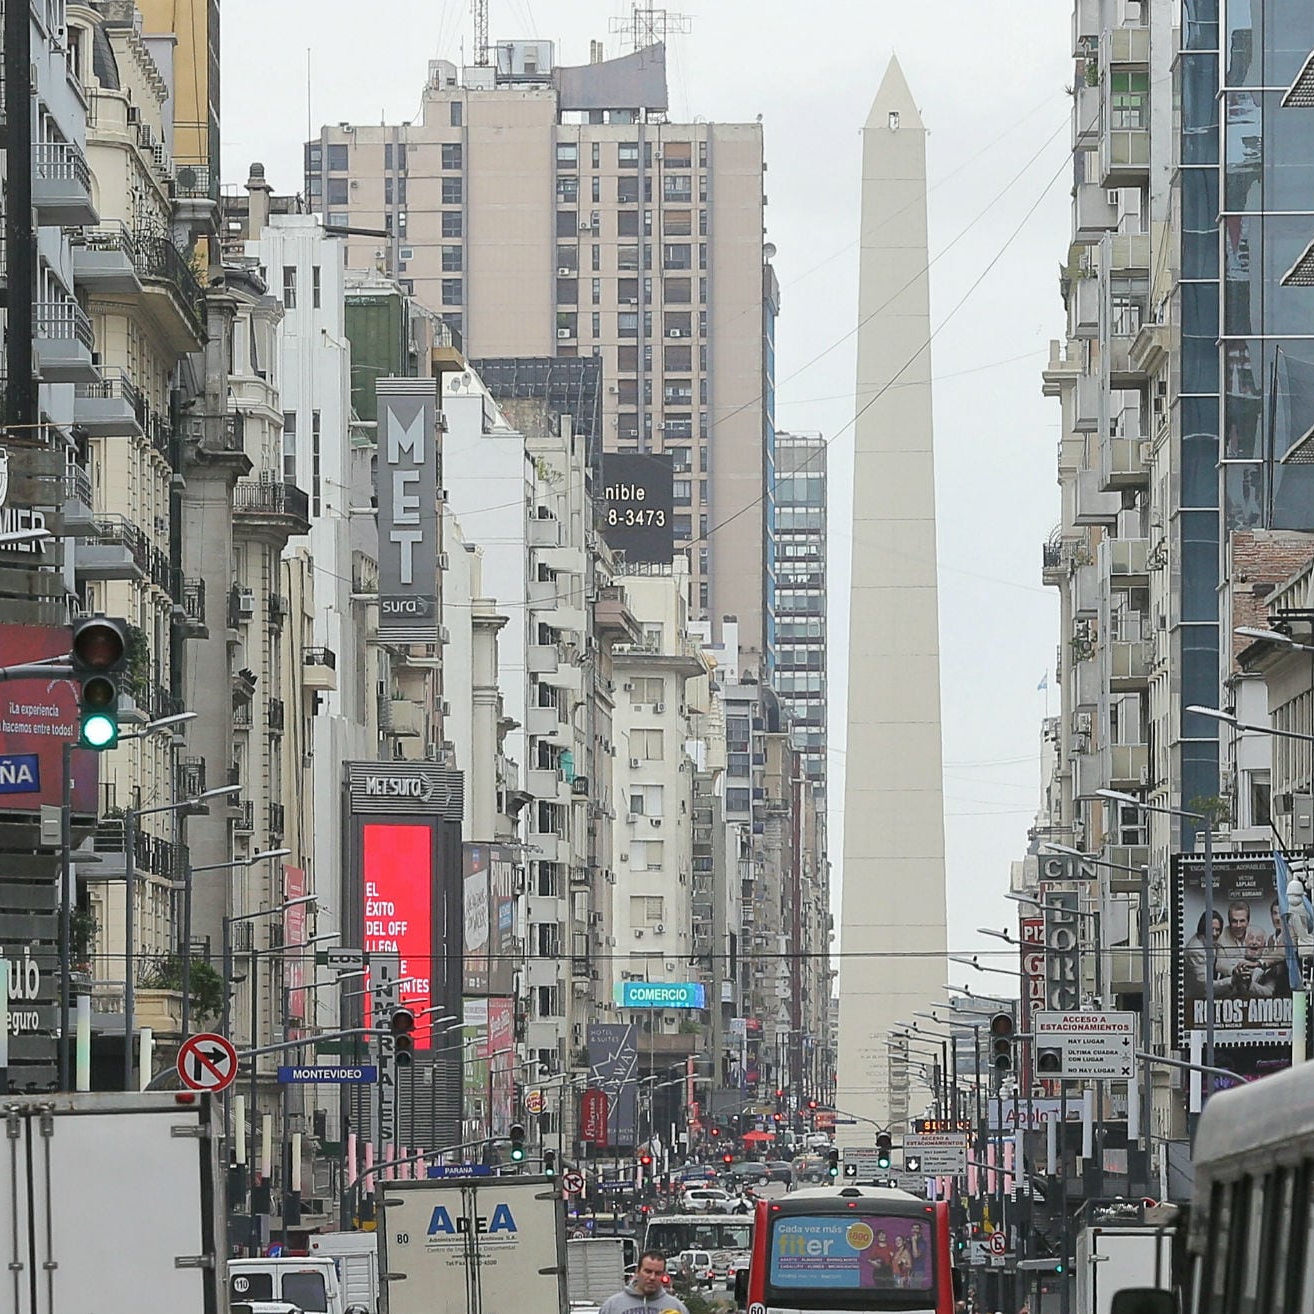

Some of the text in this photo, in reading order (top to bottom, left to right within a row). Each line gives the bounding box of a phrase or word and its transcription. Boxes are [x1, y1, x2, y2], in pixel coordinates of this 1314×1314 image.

[387, 404, 425, 584] MET
[383, 601, 416, 614] sura
[20, 702, 59, 719] experiencia
[2, 721, 32, 735] hacemos
[33, 724, 51, 735] entre
[52, 723, 73, 737] todos!
[366, 882, 379, 897] EL
[366, 900, 395, 917] ÉXITO
[366, 921, 408, 936] DEL OFF
[329, 955, 362, 965] LOS
[629, 988, 688, 1001] COMERCIO
[1040, 1023, 1129, 1031] ESTACIONAMIENTOS
[292, 1069, 363, 1080] MONTEVIDEO
[778, 1224, 843, 1234] Cada vez más
[397, 1233, 409, 1245] 80
[235, 1280, 248, 1290] 110
